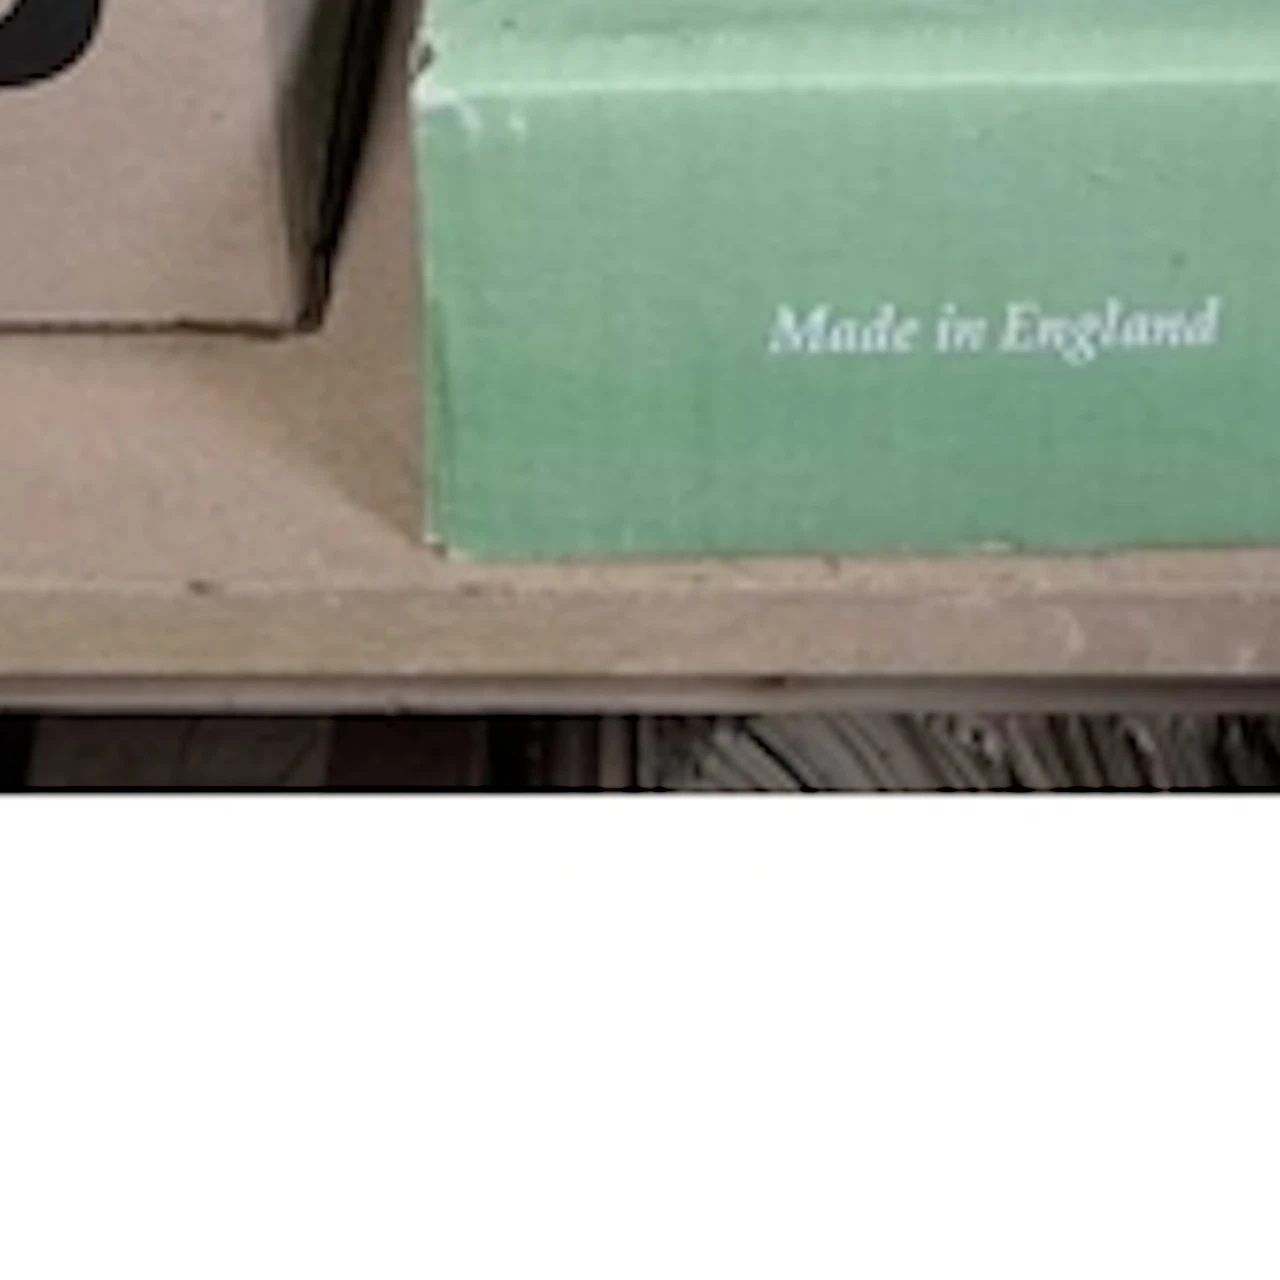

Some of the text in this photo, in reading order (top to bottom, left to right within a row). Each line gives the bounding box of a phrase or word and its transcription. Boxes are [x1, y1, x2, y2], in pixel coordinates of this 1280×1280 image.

[768, 298, 1221, 363] Made in England
